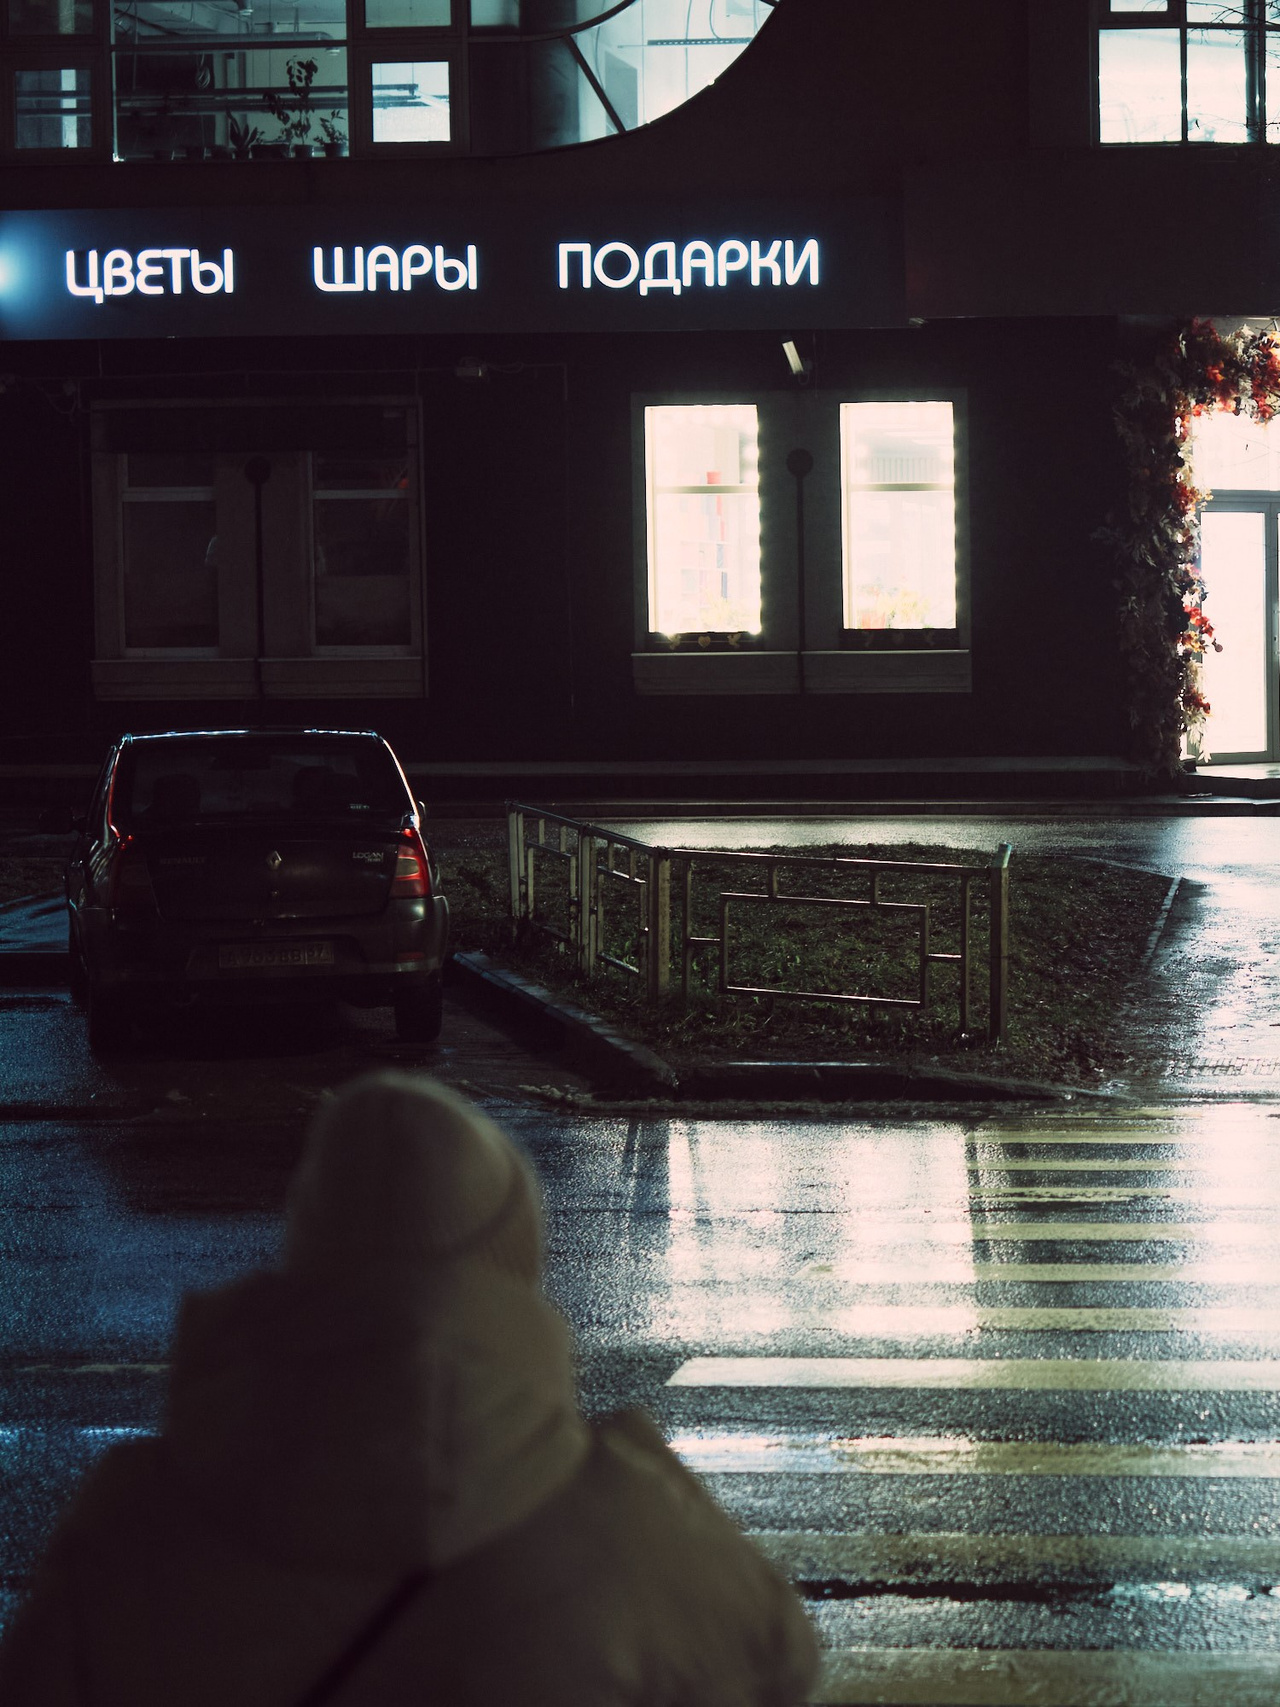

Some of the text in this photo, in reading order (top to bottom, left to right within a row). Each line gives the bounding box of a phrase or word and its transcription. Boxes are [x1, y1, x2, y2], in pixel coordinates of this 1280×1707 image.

[65, 238, 819, 304] ЦВЕТЫ ШАРЫ ПОДАРКИ
[352, 851, 384, 859] LOGAN
